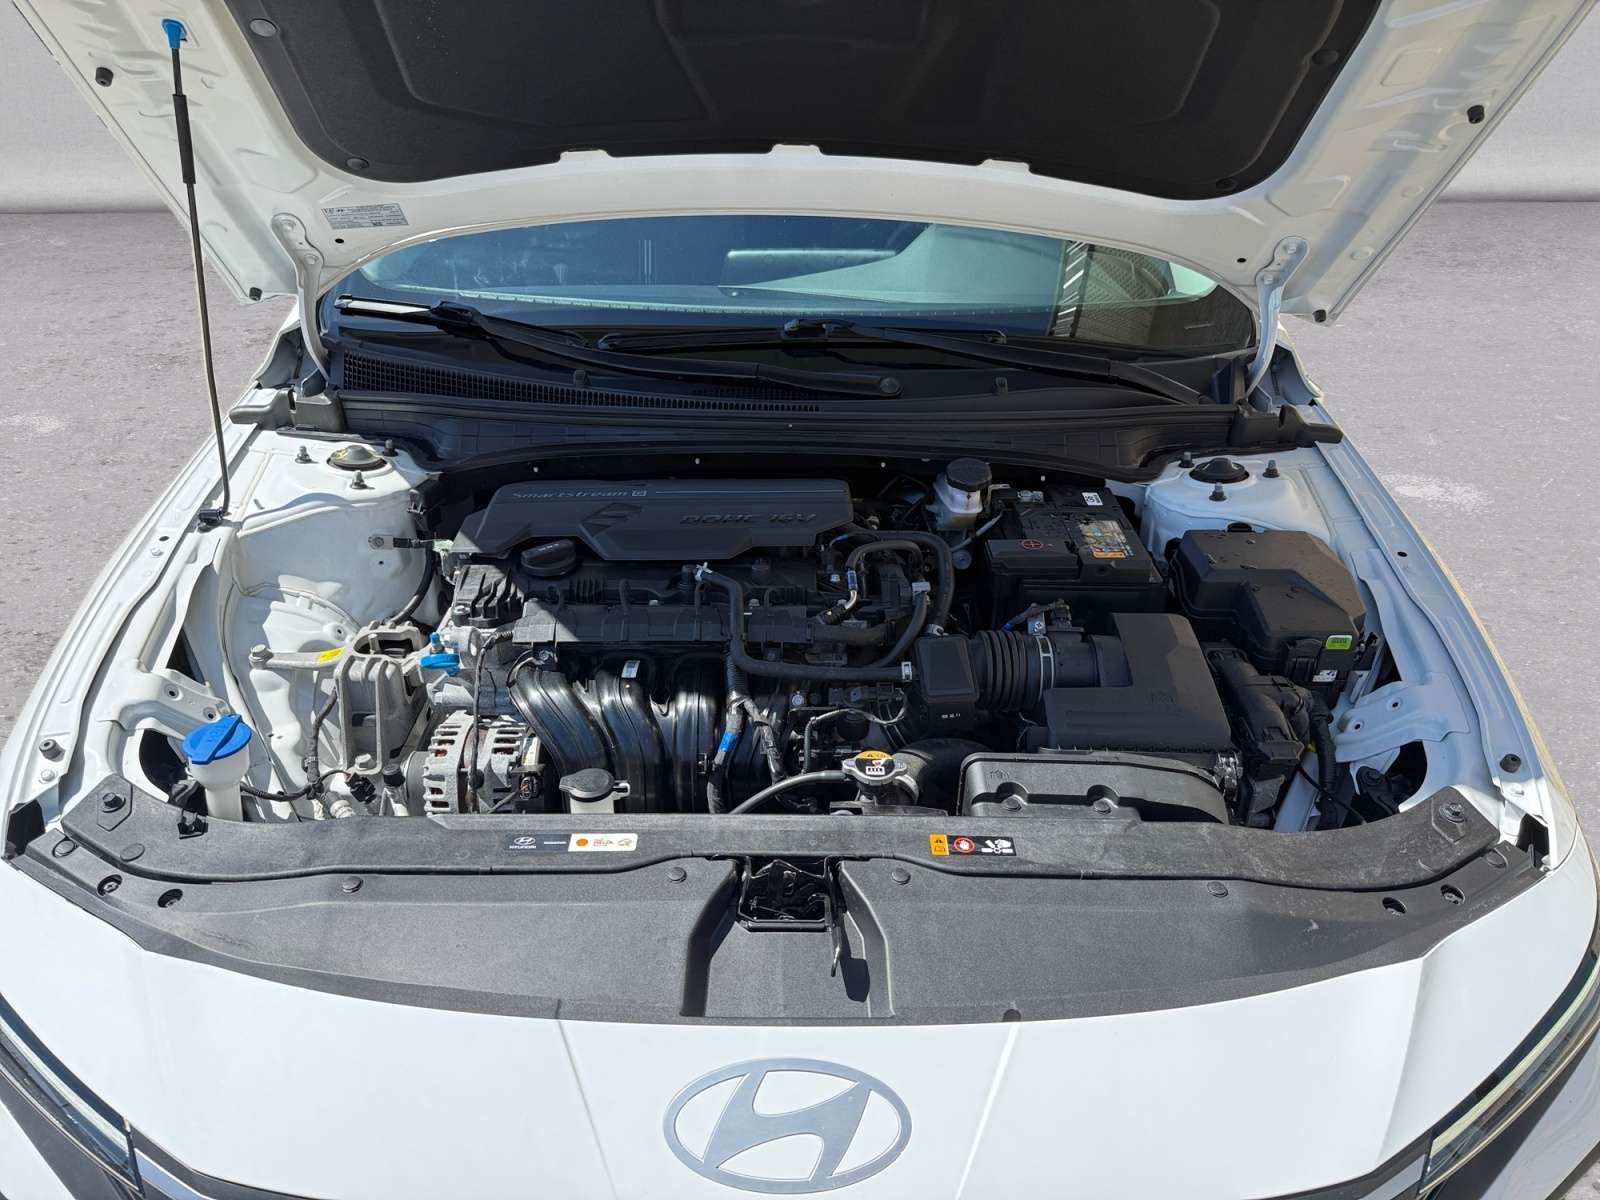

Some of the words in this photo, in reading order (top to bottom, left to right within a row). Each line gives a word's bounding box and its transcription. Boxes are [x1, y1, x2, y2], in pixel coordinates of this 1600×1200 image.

[511, 490, 628, 498] Smartstream
[680, 513, 758, 525] DOHC
[768, 513, 817, 524] 16V
